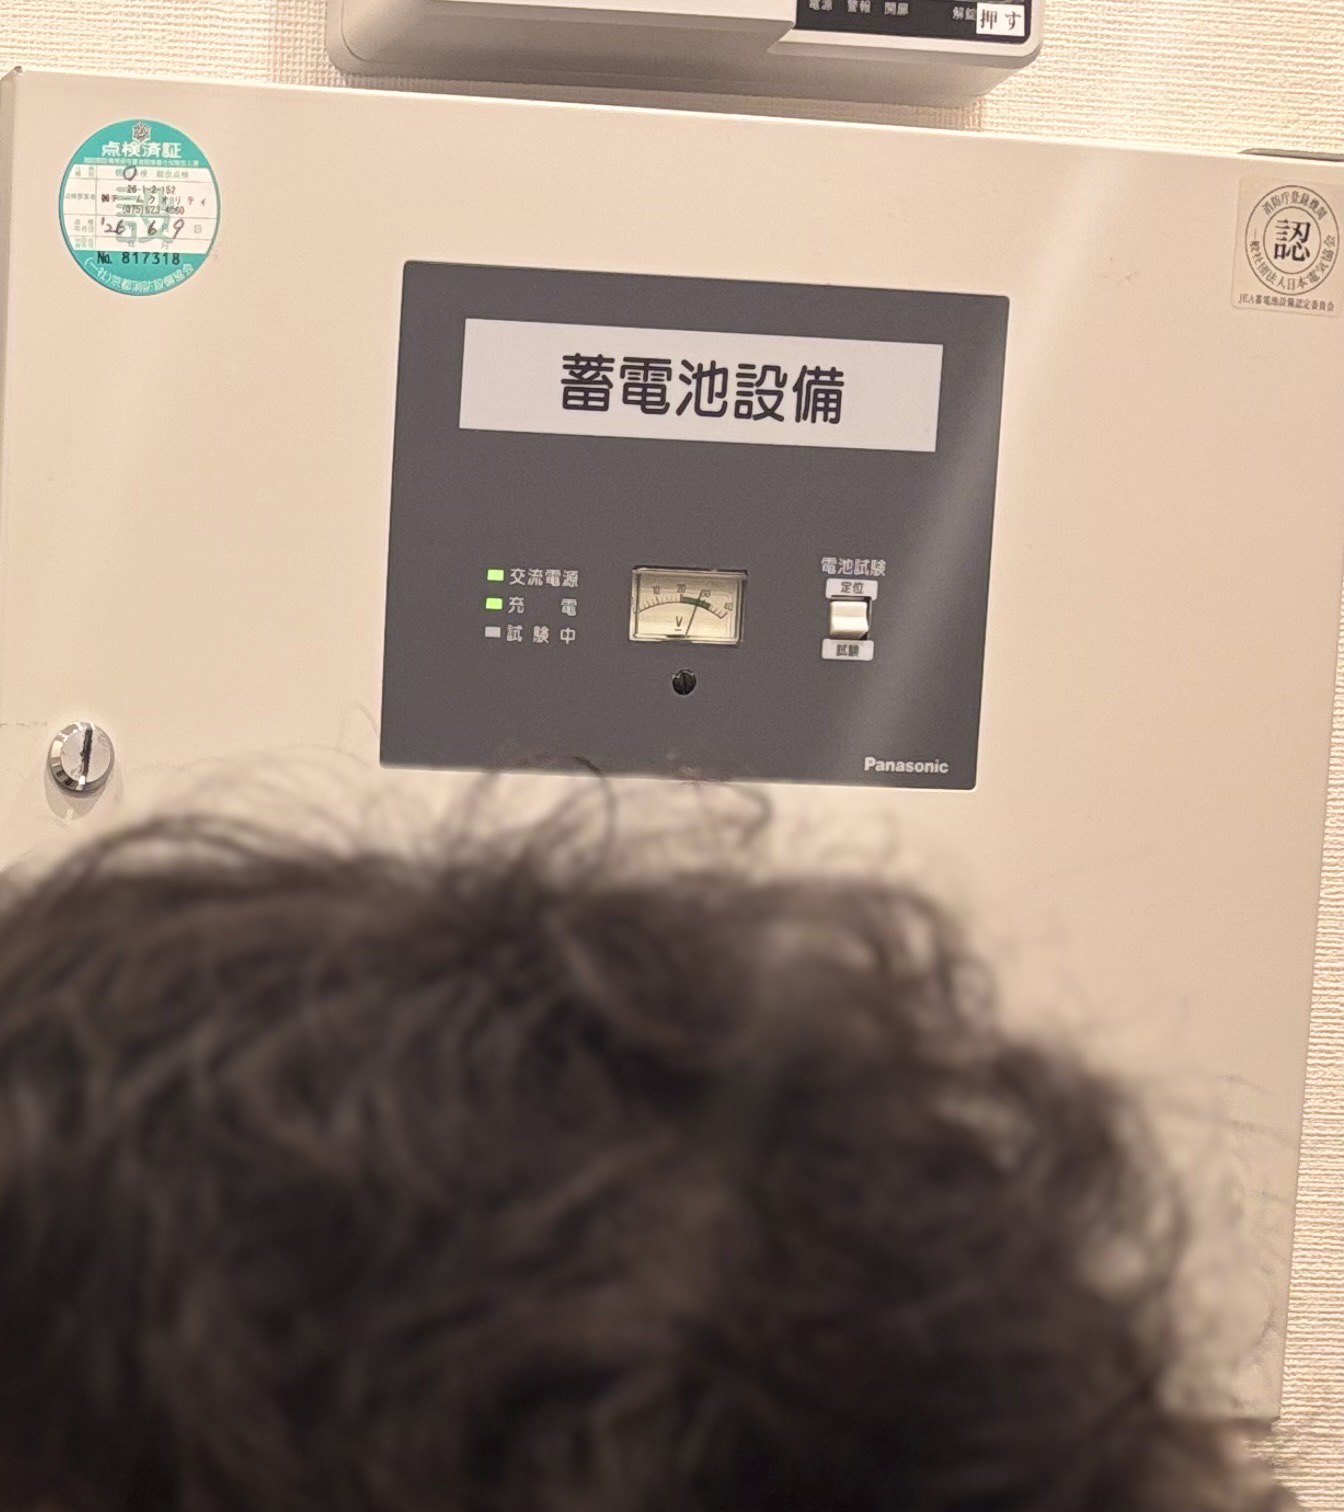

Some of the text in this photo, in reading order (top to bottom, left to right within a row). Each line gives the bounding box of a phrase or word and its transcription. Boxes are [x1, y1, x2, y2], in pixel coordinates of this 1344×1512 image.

[979, 9, 1022, 31] 押す
[101, 141, 182, 158] 点検済証
[147, 218, 185, 239] 6 9
[1273, 219, 1311, 262] 認
[121, 252, 181, 265] 817318
[560, 352, 846, 427] 蓄電池設備
[820, 557, 887, 577] 電池試験
[509, 568, 580, 588] 交流電源
[840, 580, 864, 595] 定位
[506, 624, 577, 645] 試験中
[864, 755, 950, 775] Panasonic
